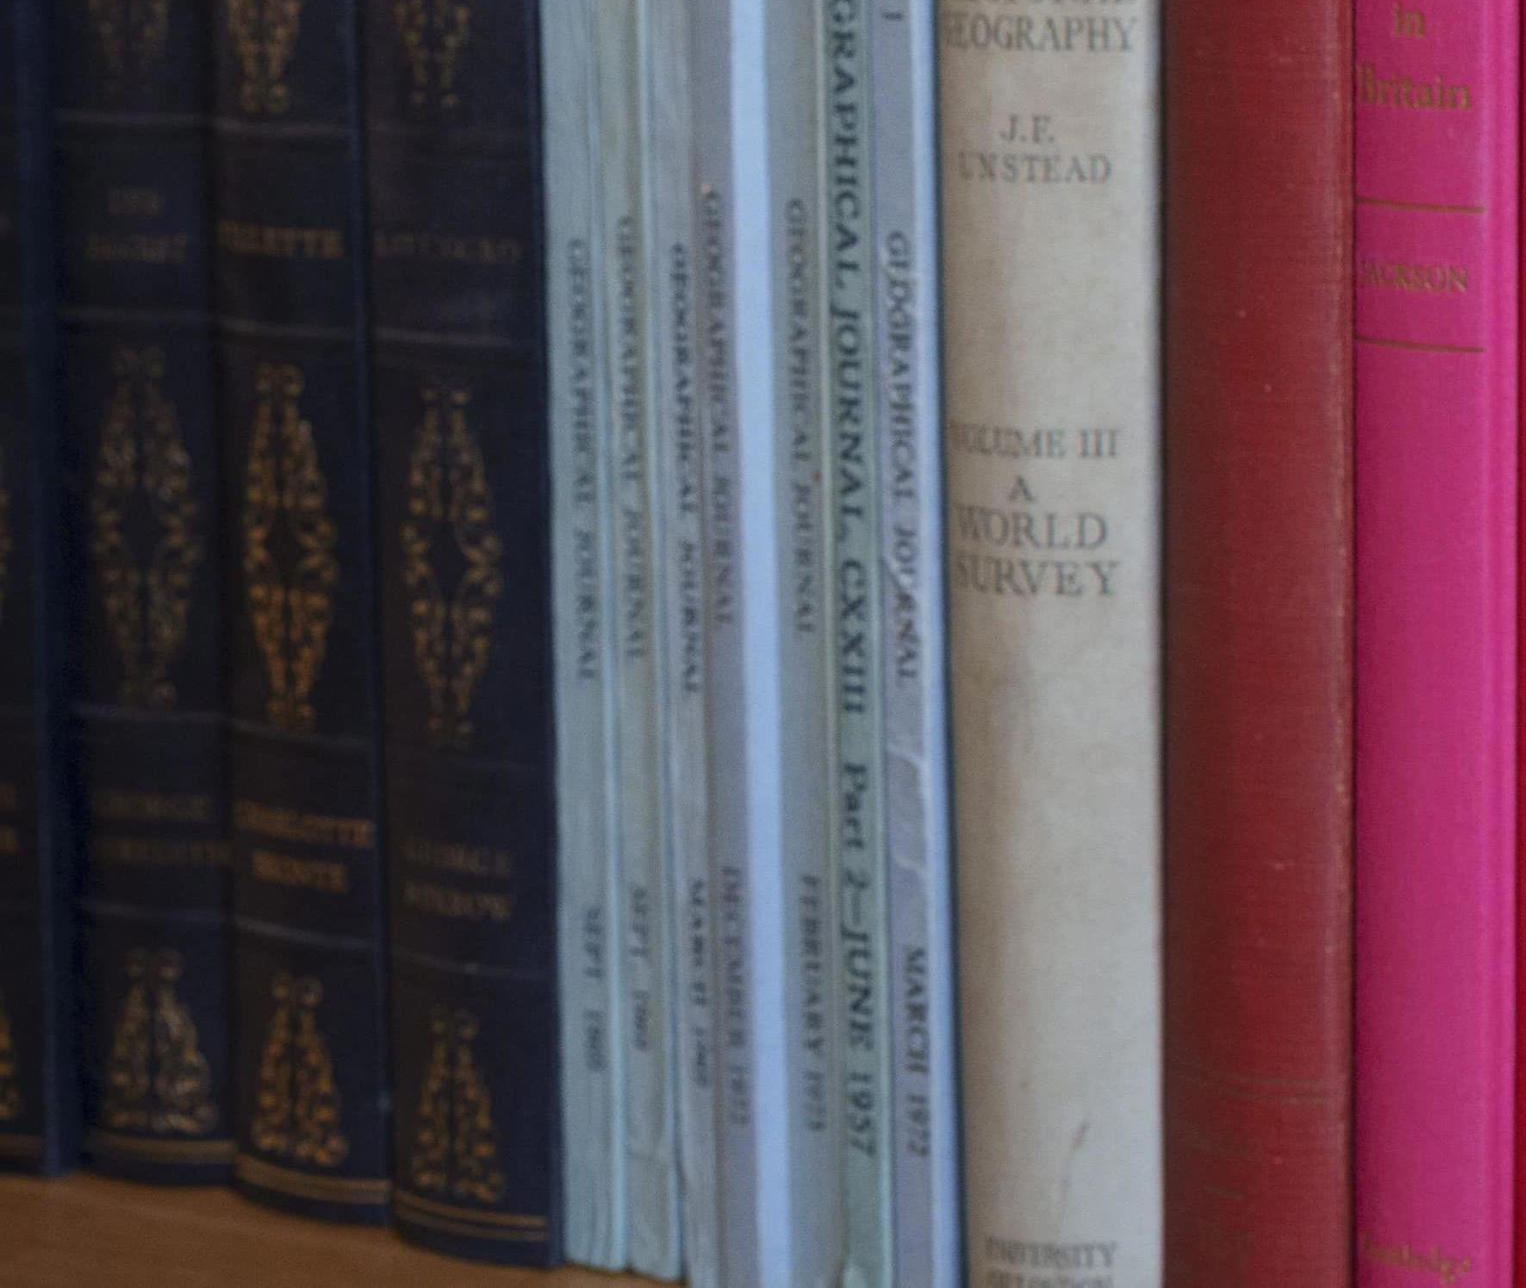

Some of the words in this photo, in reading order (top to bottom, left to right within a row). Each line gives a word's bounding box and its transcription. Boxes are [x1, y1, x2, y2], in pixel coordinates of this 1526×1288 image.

[943, 11, 1139, 51] GEOGRAPHY
[1392, 2, 1426, 38] in
[1357, 62, 1472, 111] Britain
[960, 151, 1113, 185] UNSTEAD
[786, 199, 813, 465] GEOGRAPHICAL
[884, 231, 916, 504] GEOGRAPHICAL
[1078, 428, 1121, 458] III
[1009, 474, 1034, 502] A
[792, 481, 816, 636] JOURNAL
[953, 503, 1109, 550] WORLD
[895, 527, 919, 686] JOURNAL
[953, 553, 1122, 595] SURVEY
[842, 763, 870, 849] Part
[800, 873, 826, 1058] FEBRUARY
[903, 945, 930, 1075] MARCH
[847, 1072, 875, 1159] 1957
